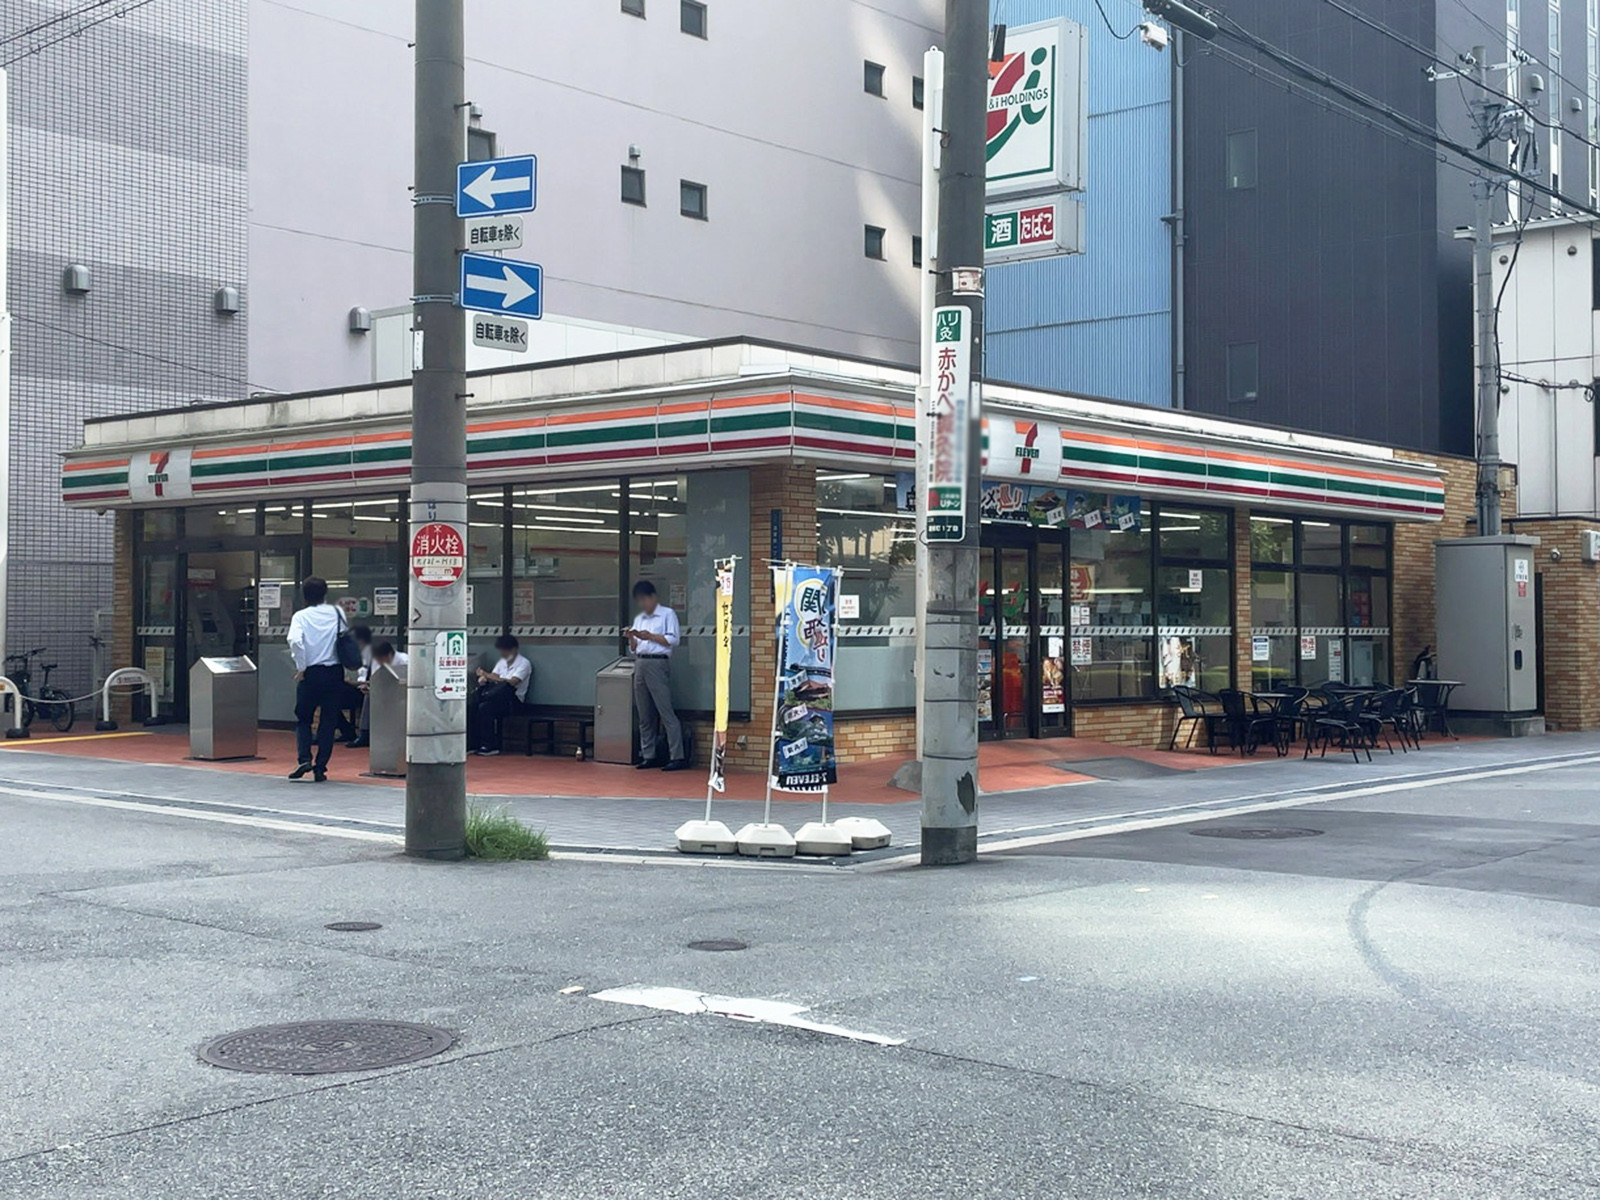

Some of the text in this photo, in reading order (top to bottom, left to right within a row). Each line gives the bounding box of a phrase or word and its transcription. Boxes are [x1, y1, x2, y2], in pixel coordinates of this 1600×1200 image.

[1000, 88, 1049, 106] HOLDINGS
[470, 224, 521, 245] 自転車を除く
[991, 216, 1012, 244] 酒
[1021, 212, 1053, 239] たばこ
[937, 312, 959, 327] ハリ
[475, 322, 527, 346] 自転車を除く
[939, 327, 953, 342] 灸
[940, 499, 960, 508] Uターン
[416, 534, 460, 555] 消火栓
